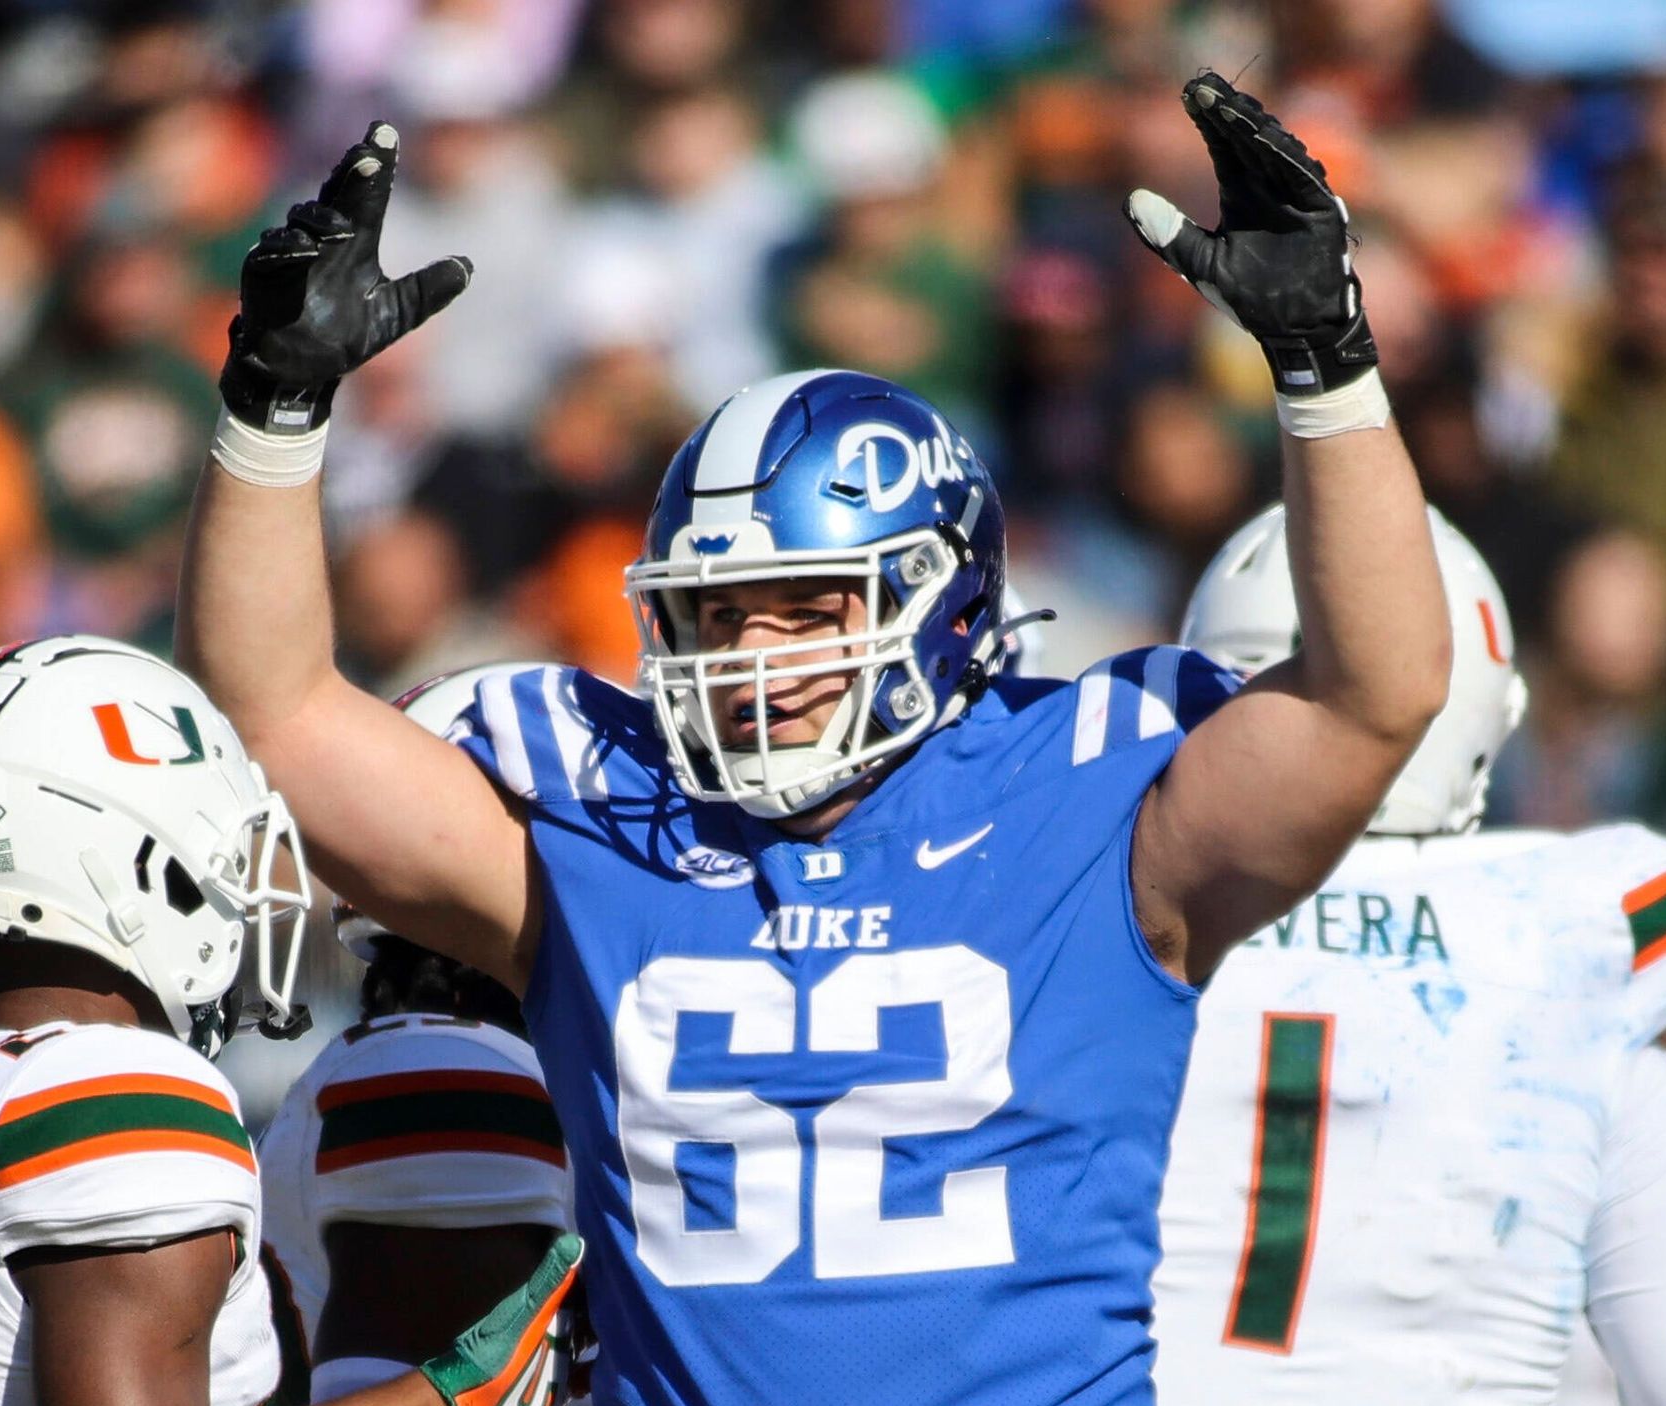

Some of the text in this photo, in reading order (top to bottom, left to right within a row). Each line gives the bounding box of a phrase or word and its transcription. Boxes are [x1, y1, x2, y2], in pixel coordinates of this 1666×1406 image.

[1243, 893, 1449, 960] VERA
[616, 945, 1016, 1287] 62
[1221, 1012, 1335, 1356] 1
